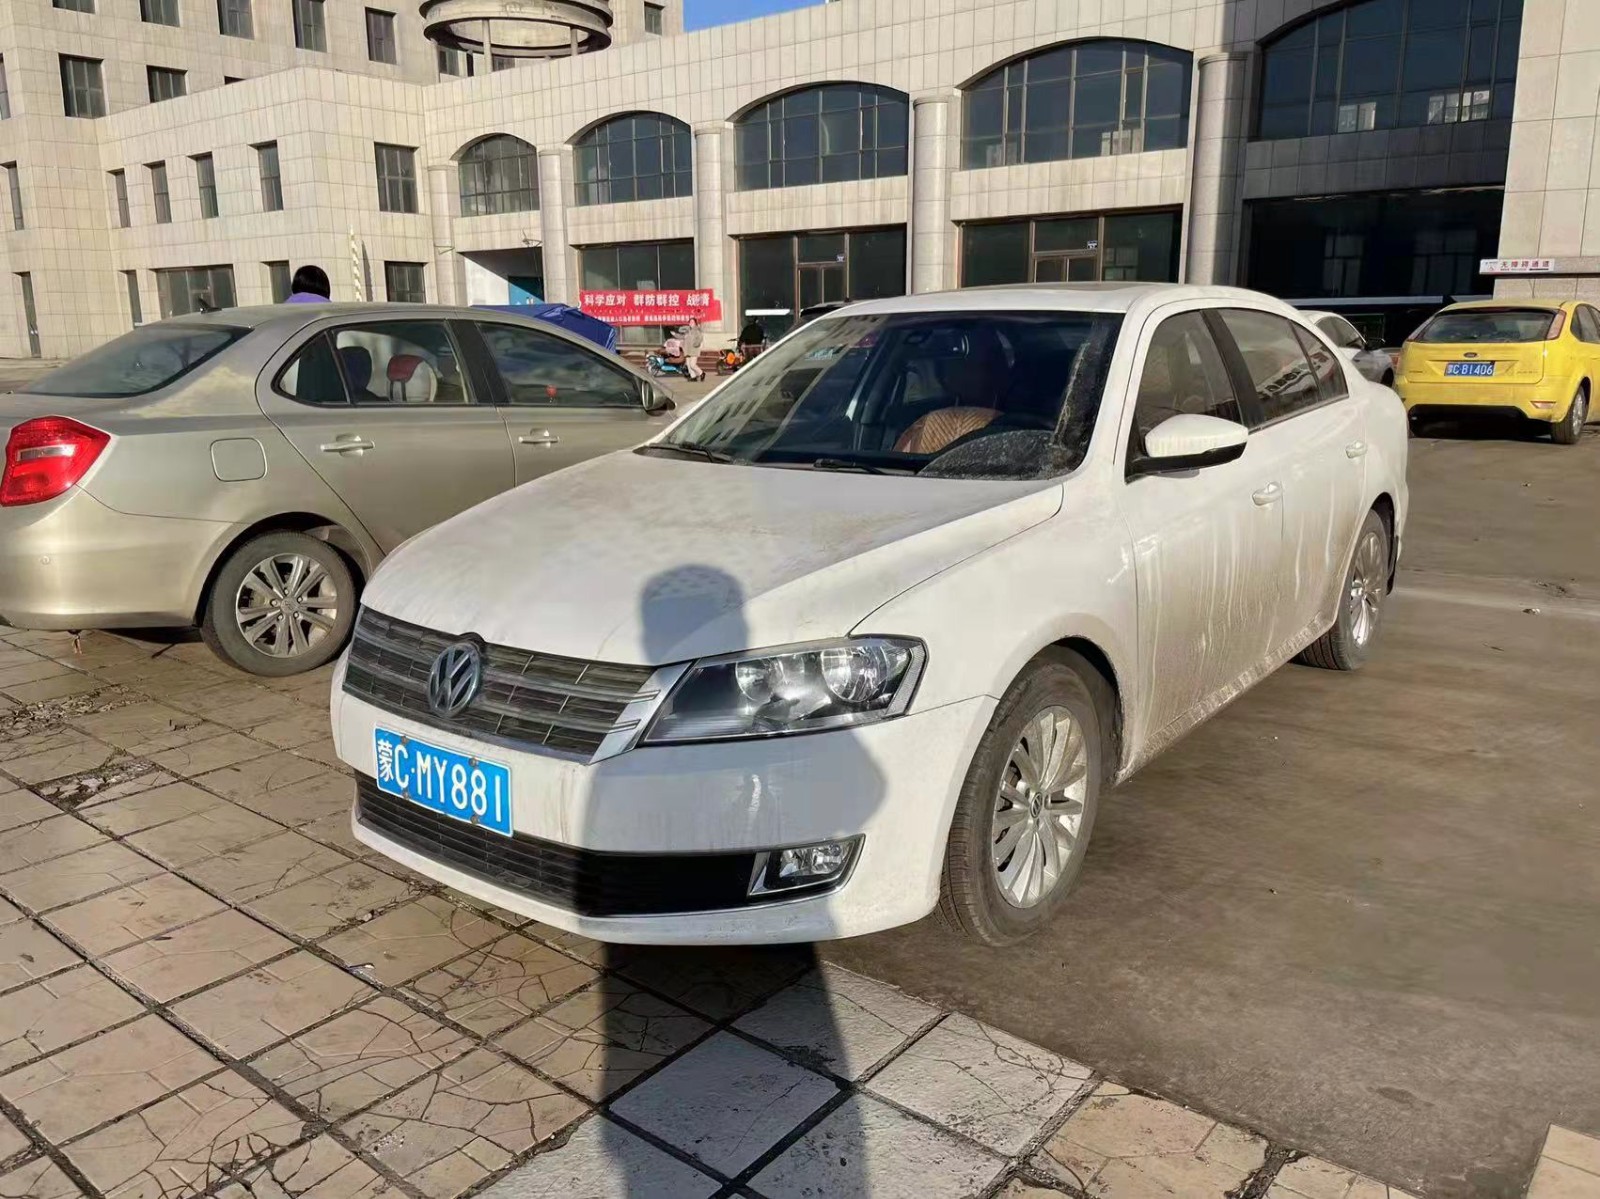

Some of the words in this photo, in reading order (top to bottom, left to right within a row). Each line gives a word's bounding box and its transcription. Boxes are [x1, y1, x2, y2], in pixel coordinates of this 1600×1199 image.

[584, 294, 627, 307] 科学应对
[633, 293, 680, 307] 群防群控
